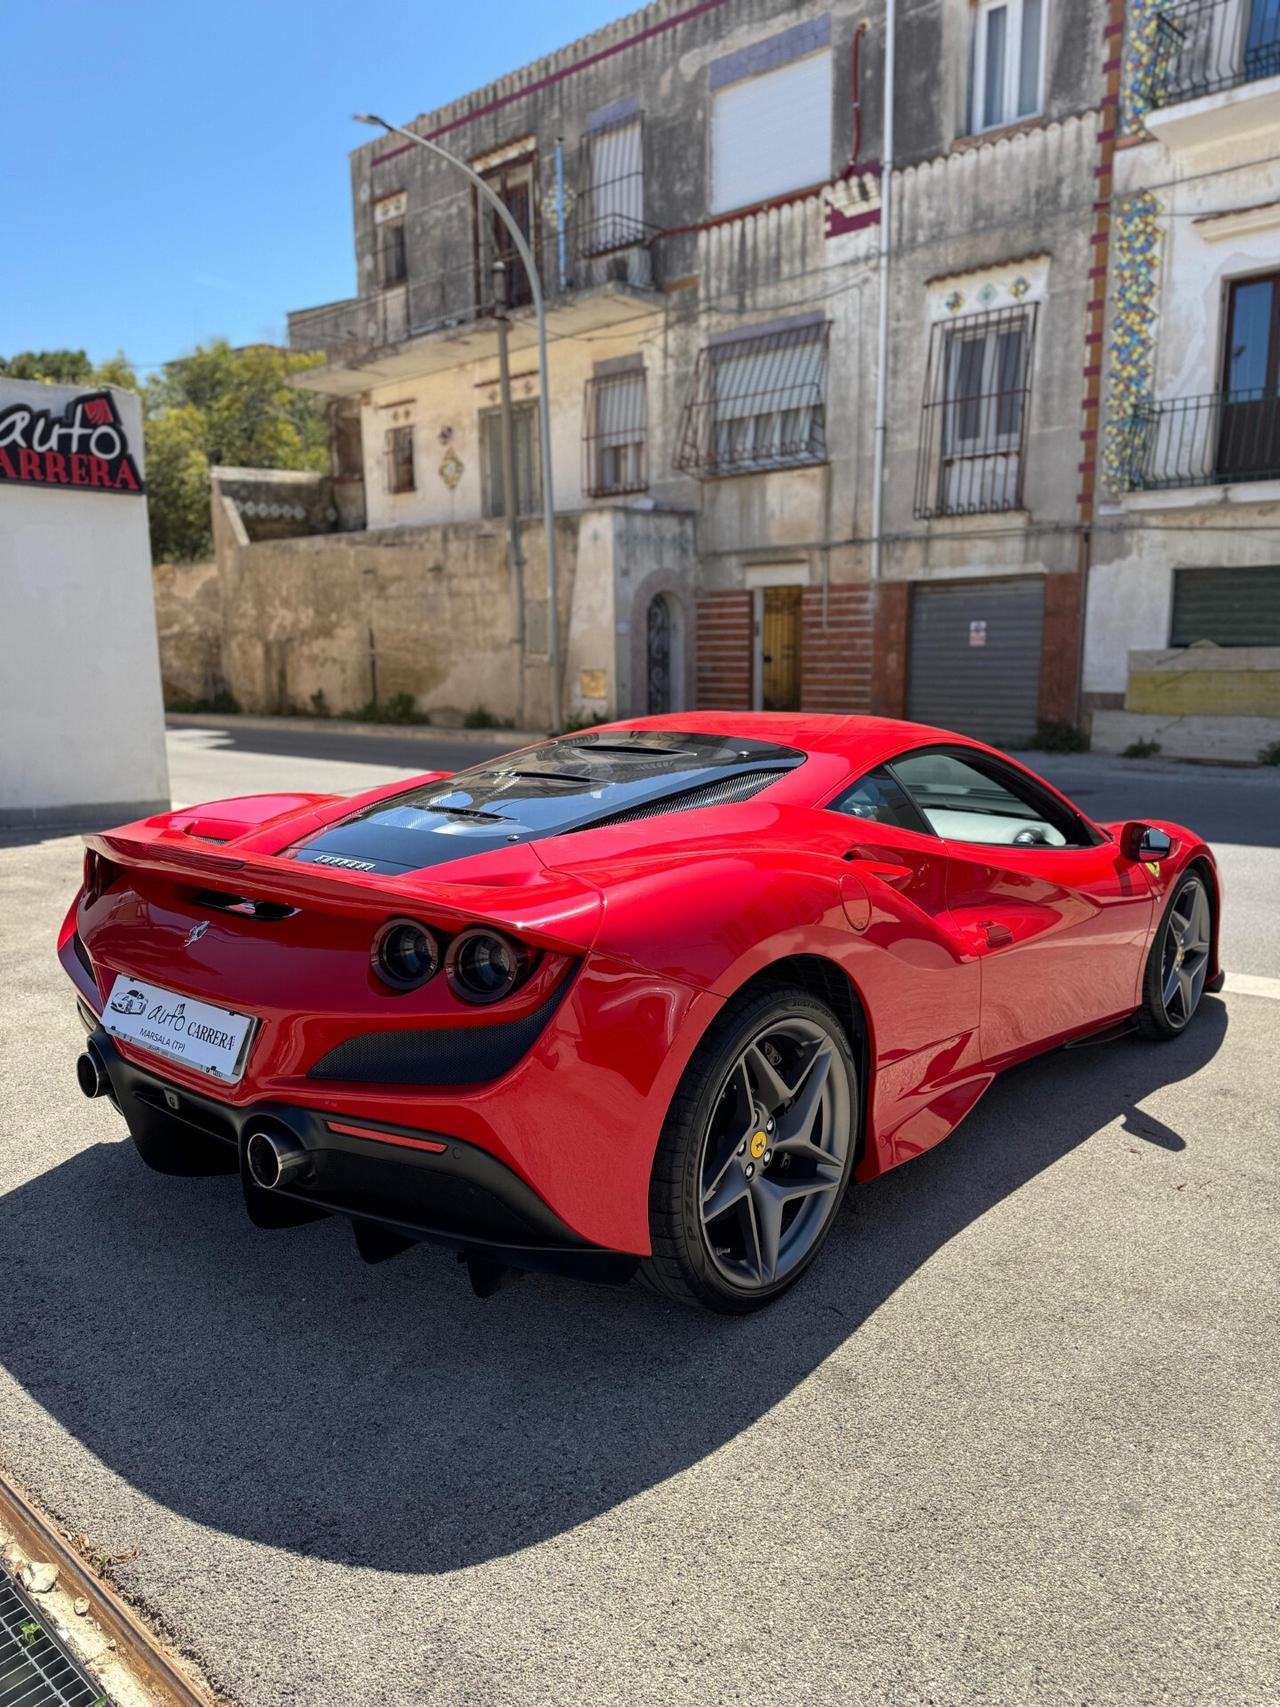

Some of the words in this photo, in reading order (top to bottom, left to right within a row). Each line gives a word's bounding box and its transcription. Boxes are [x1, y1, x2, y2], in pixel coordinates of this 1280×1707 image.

[0, 404, 121, 459] auto
[139, 1027, 171, 1047] MARSALA
[170, 1039, 186, 1053] (TP)
[147, 1004, 186, 1032] auto
[187, 1021, 233, 1051] CARRERA
